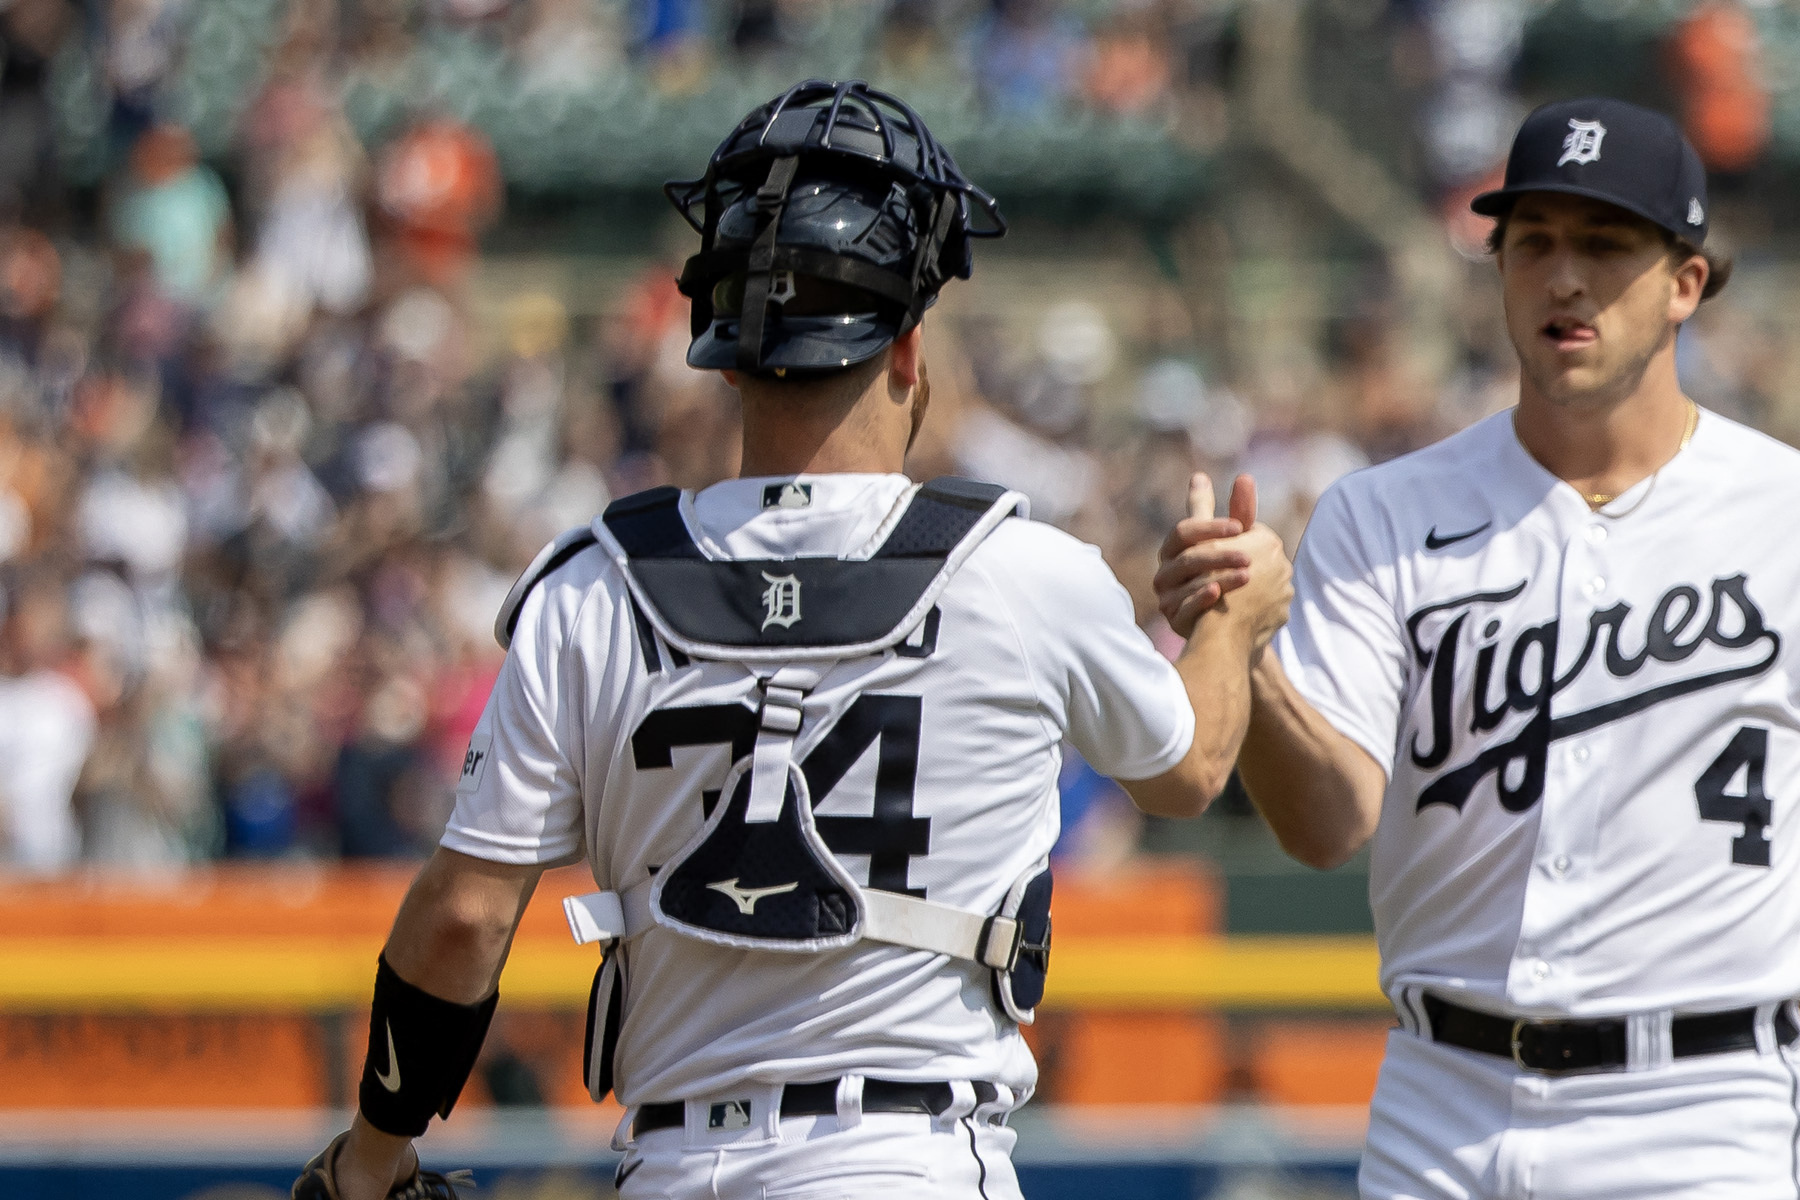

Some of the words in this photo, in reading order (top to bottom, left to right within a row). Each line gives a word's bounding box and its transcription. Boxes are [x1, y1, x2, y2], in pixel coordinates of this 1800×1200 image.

[1556, 117, 1607, 167] D
[761, 570, 802, 633] D
[1405, 571, 1781, 817] Tigres
[1694, 725, 1773, 867] 4
